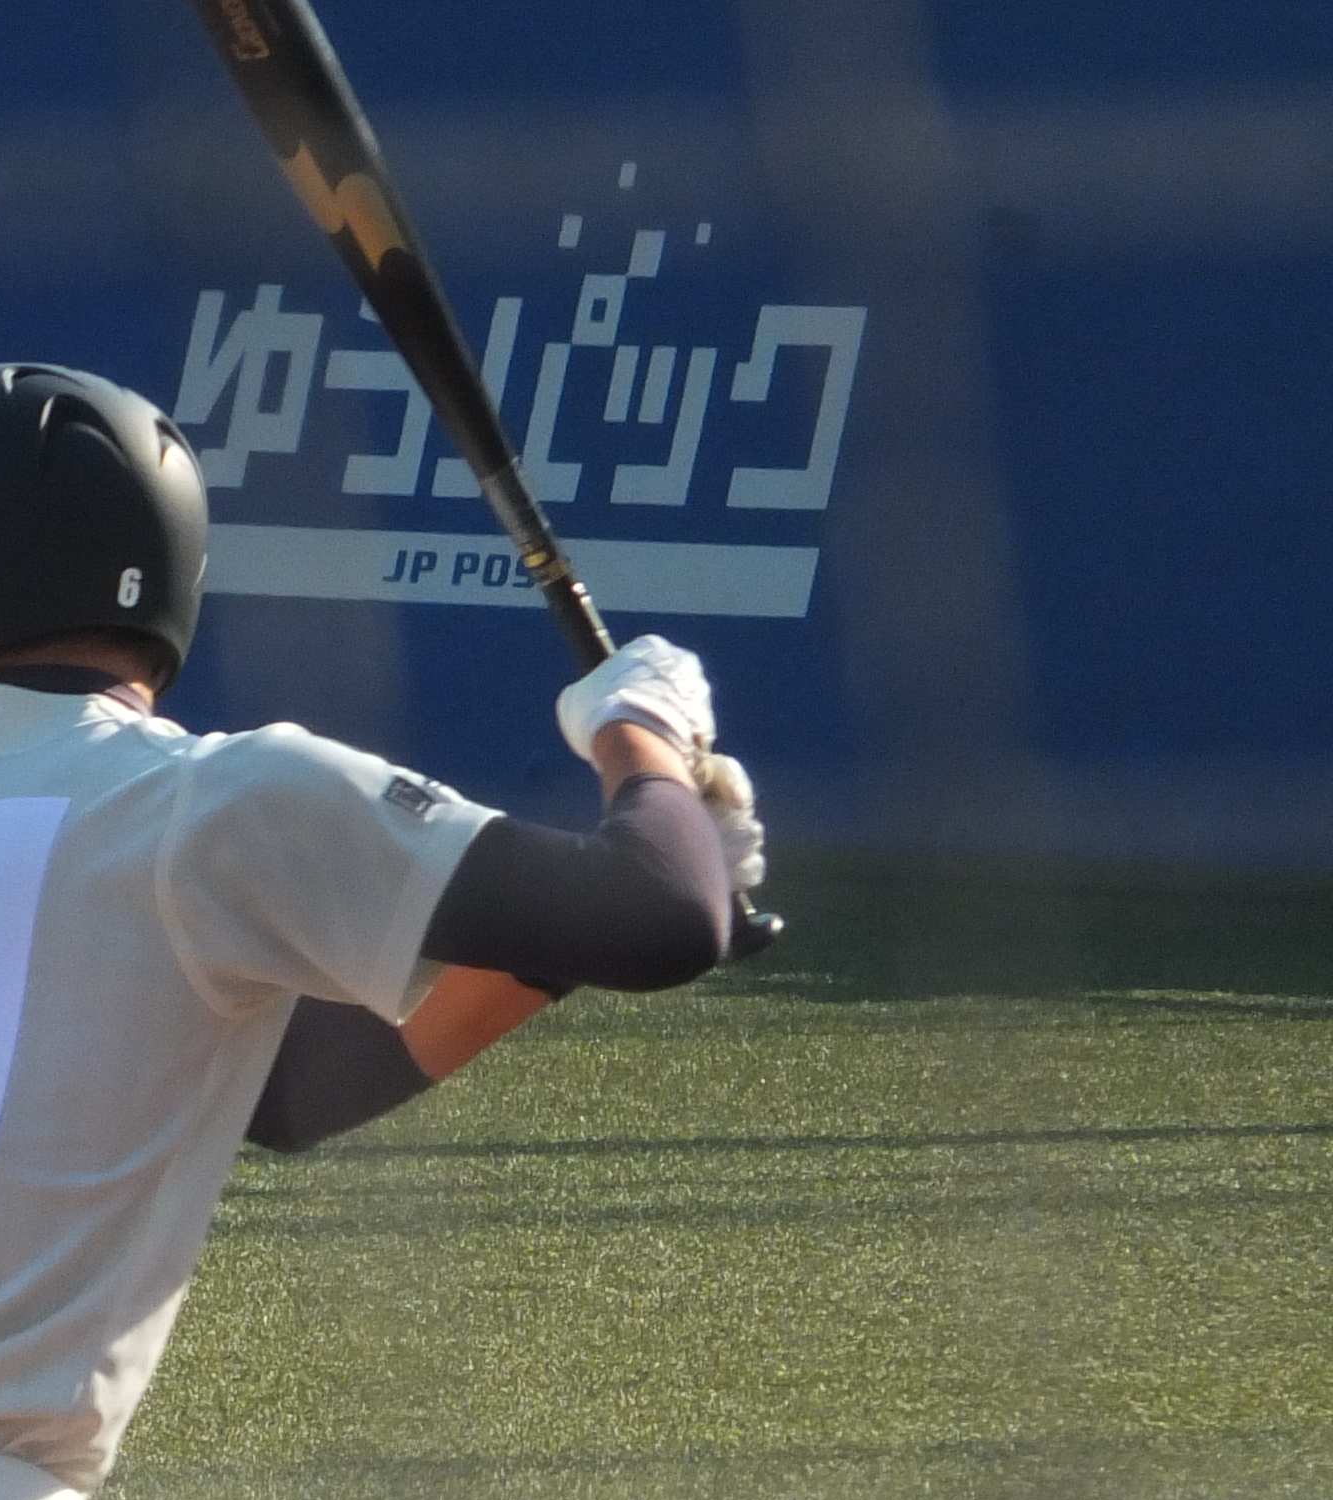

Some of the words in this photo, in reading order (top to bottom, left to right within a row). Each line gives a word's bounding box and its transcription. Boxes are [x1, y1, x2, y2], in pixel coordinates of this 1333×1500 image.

[117, 567, 143, 608] 6
[382, 549, 438, 584] JP
[451, 551, 538, 589] POS
